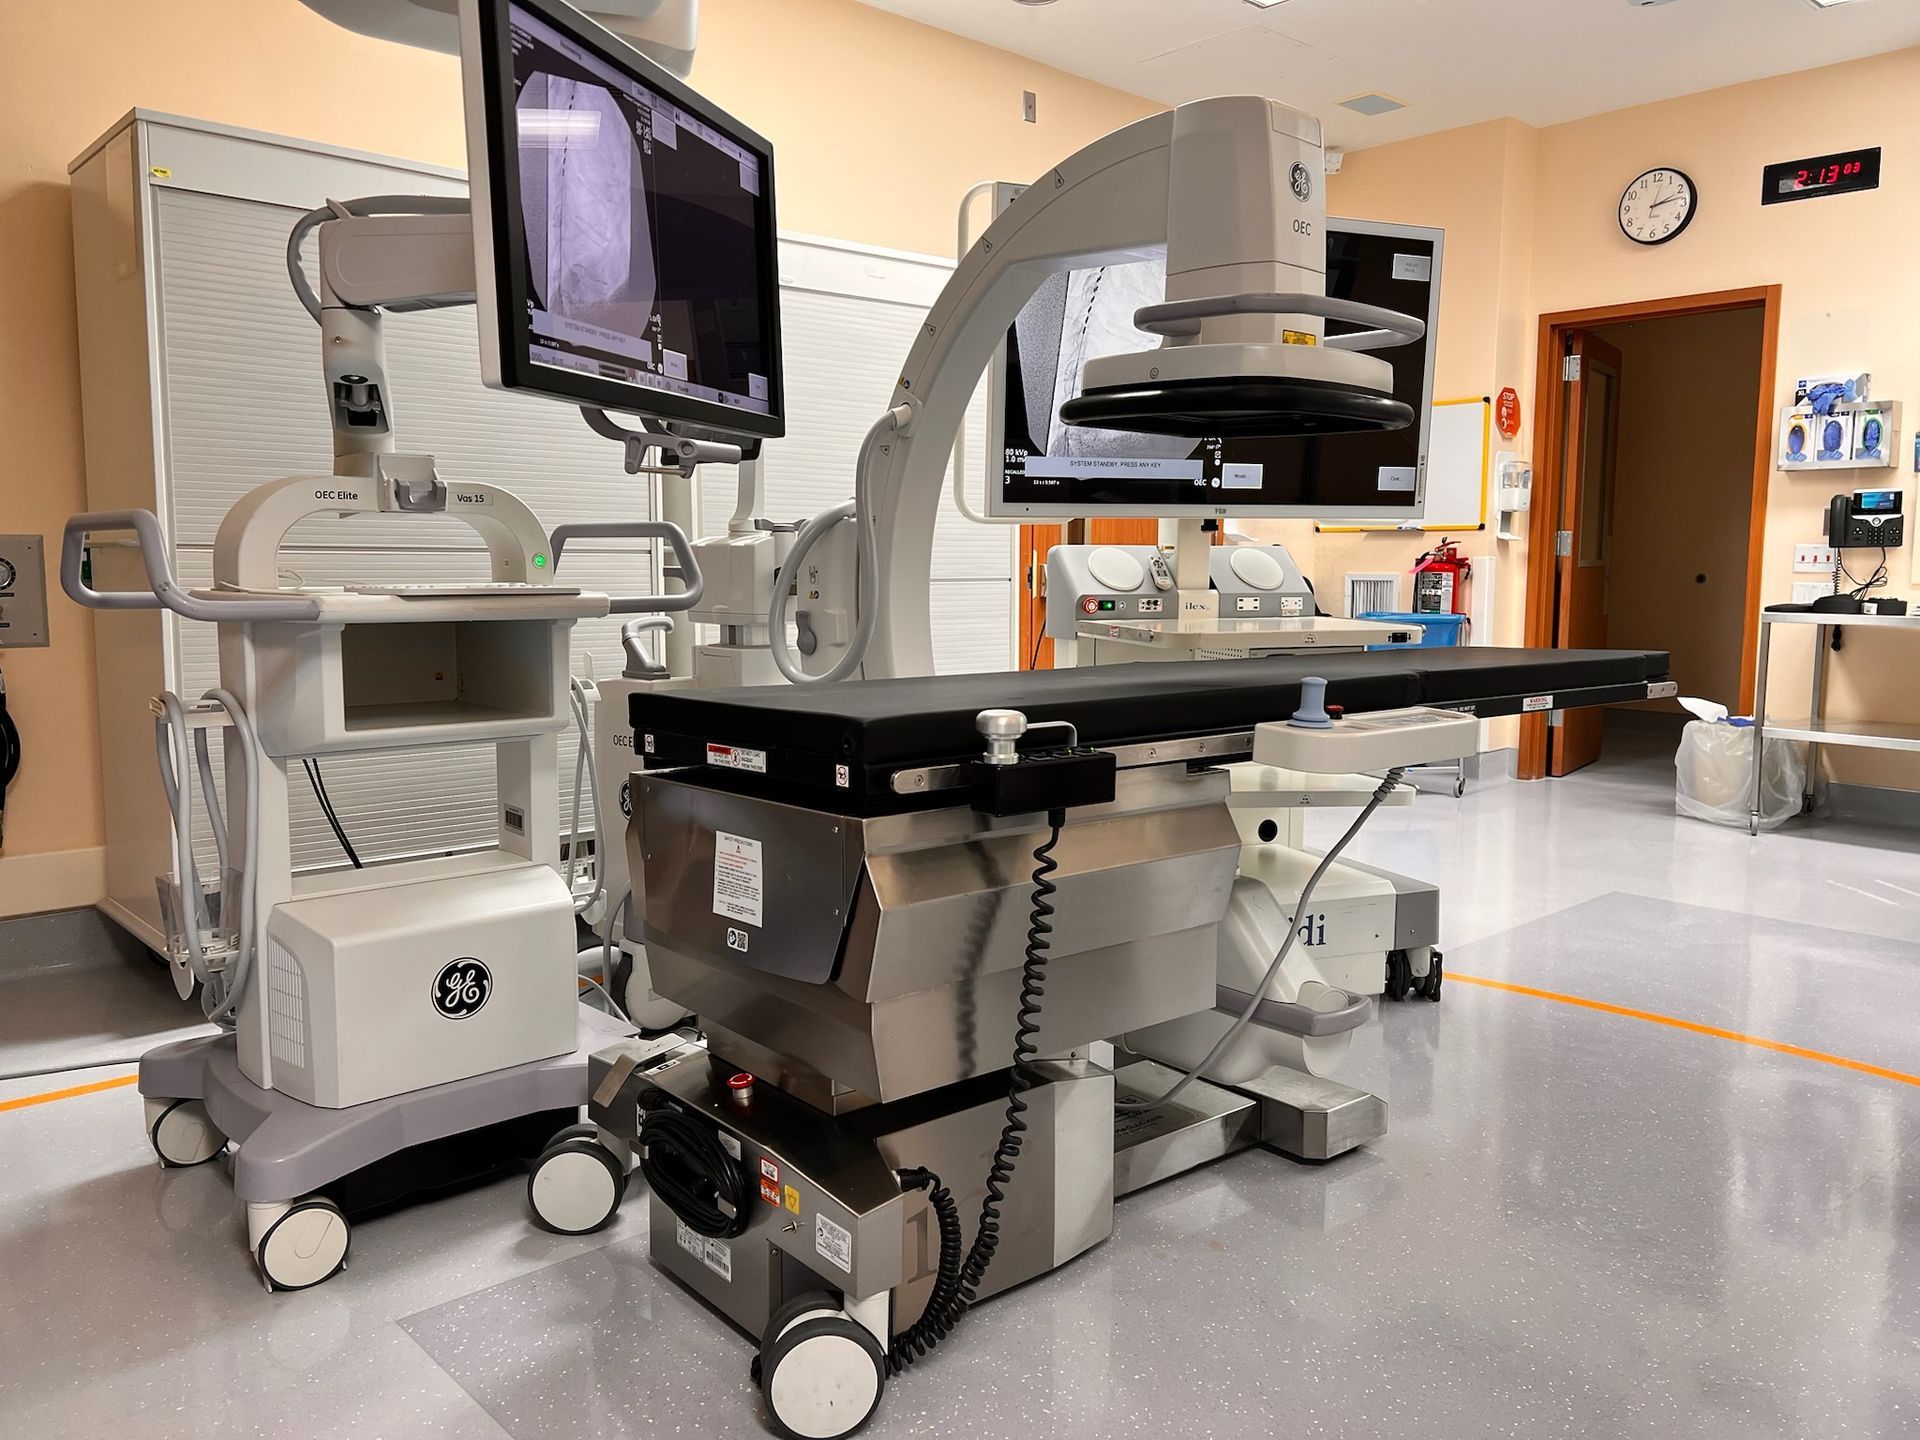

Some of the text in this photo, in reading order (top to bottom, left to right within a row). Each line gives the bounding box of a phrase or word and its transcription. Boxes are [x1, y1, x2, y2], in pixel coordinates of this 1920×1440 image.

[1653, 172, 1664, 183] 12
[1668, 175, 1673, 185] 1
[1794, 162, 1861, 189] 2:13 03
[1640, 179, 1648, 189] 11
[1677, 184, 1684, 194] 2
[1627, 190, 1638, 201] 10
[1680, 197, 1687, 207] 3
[1624, 204, 1631, 215] 9
[1674, 211, 1681, 221] 4
[1626, 217, 1633, 227] 8
[1293, 219, 1311, 236] OEC
[1636, 226, 1643, 237] 7
[1662, 223, 1670, 234] 5
[1649, 228, 1656, 239] 6
[1005, 448, 1028, 457] 80 kVp
[1004, 476, 1011, 484] 3
[314, 490, 359, 501] OEC Elite
[474, 494, 485, 503] 15
[1185, 602, 1206, 610] ilex
[613, 734, 628, 747] OEC
